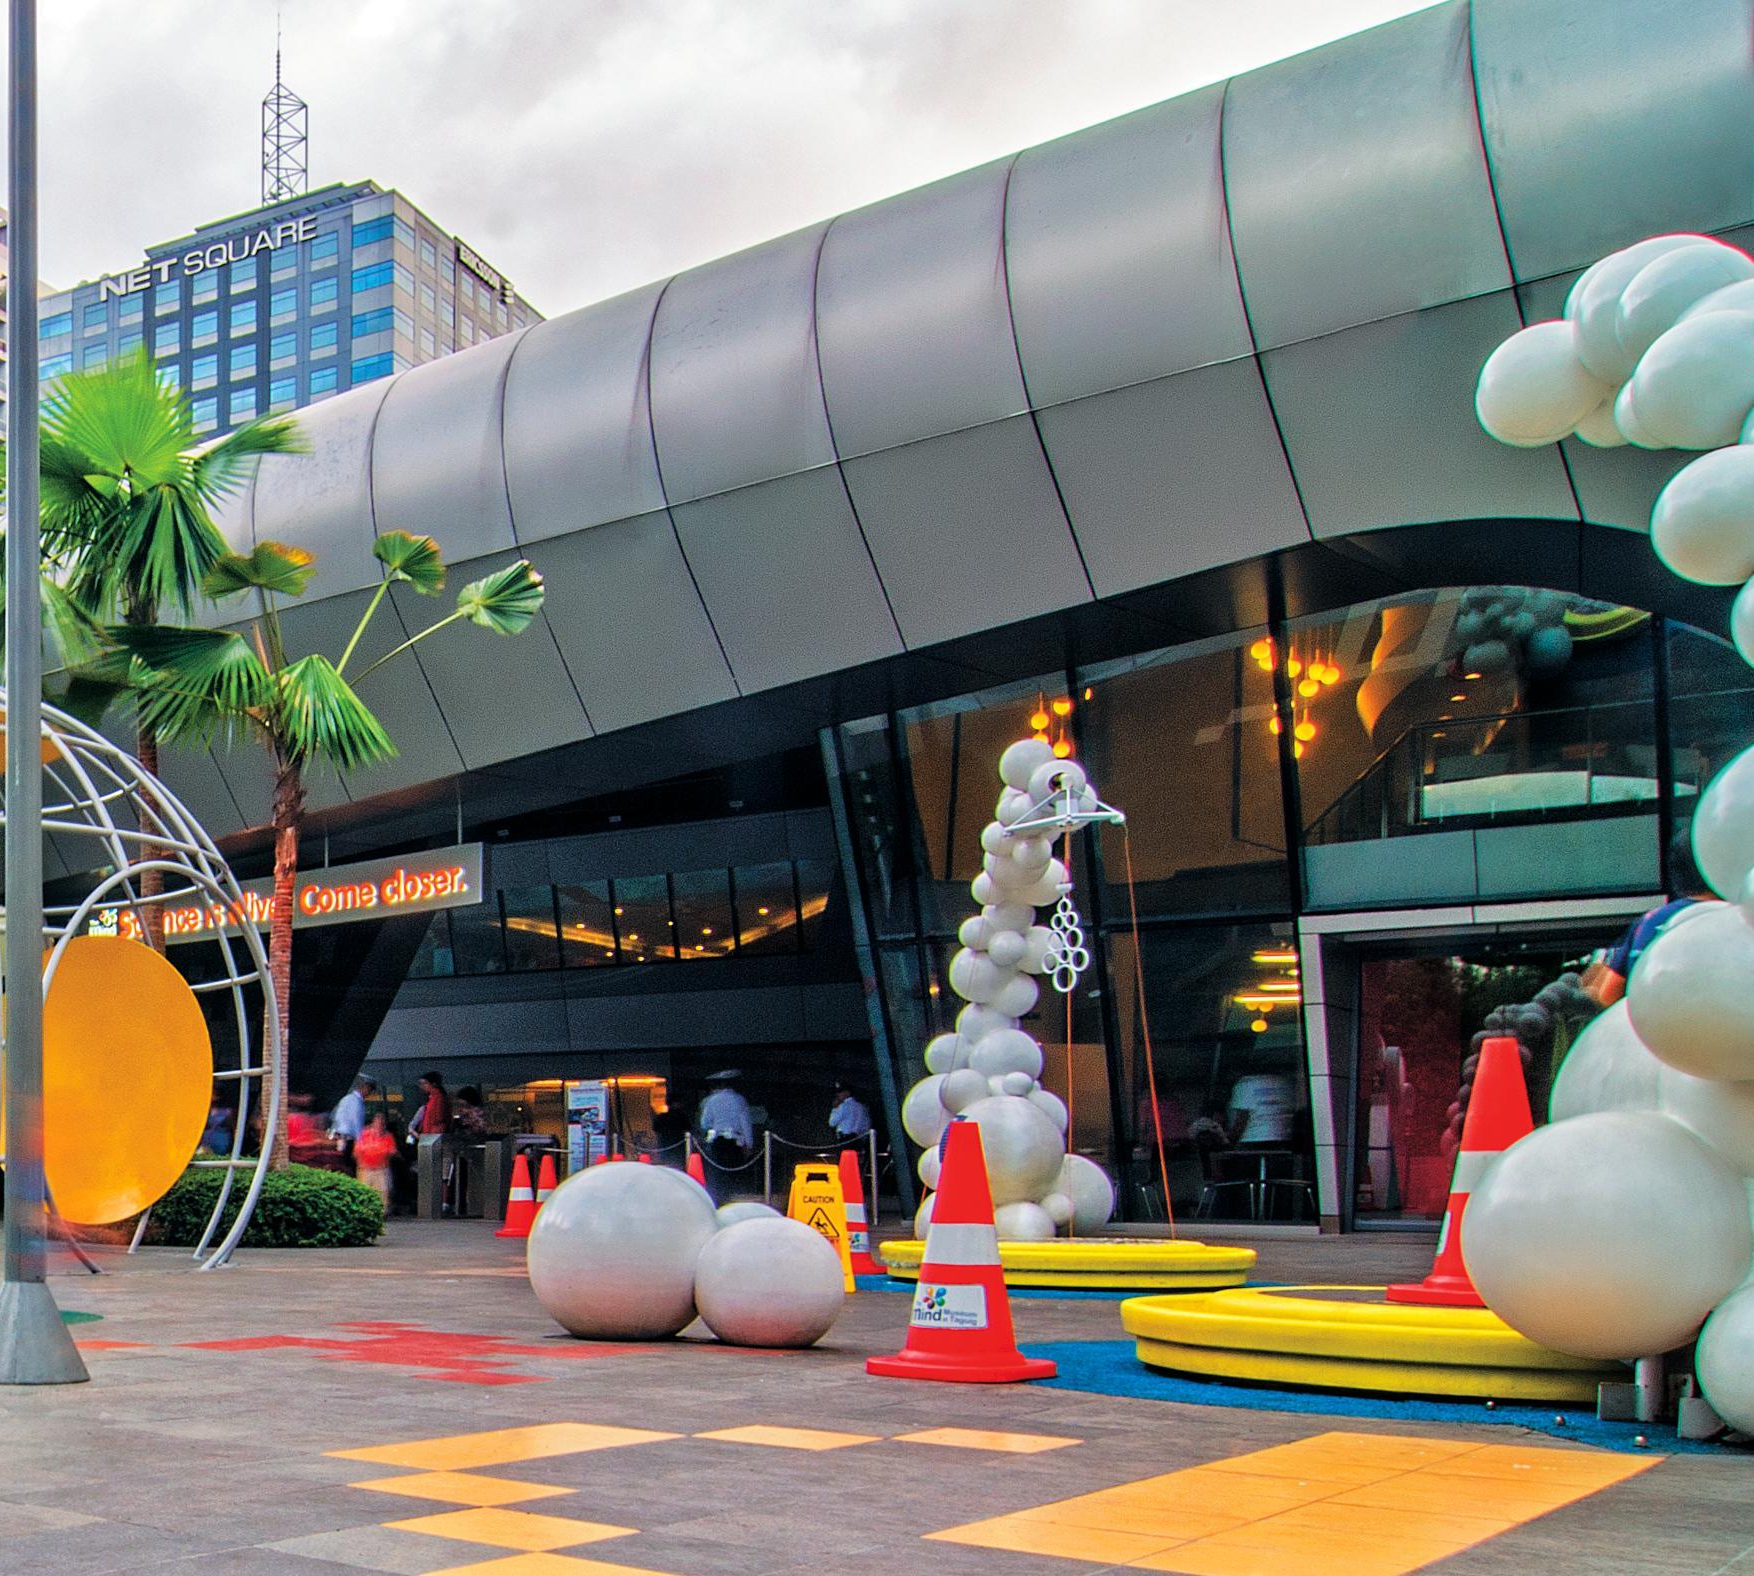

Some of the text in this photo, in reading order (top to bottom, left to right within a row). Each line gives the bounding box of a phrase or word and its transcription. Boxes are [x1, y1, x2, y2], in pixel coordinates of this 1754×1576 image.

[100, 214, 318, 302] NET SQUARE
[299, 883, 378, 917] Come
[379, 867, 469, 906] closer.
[802, 1195, 835, 1204] CAUTION
